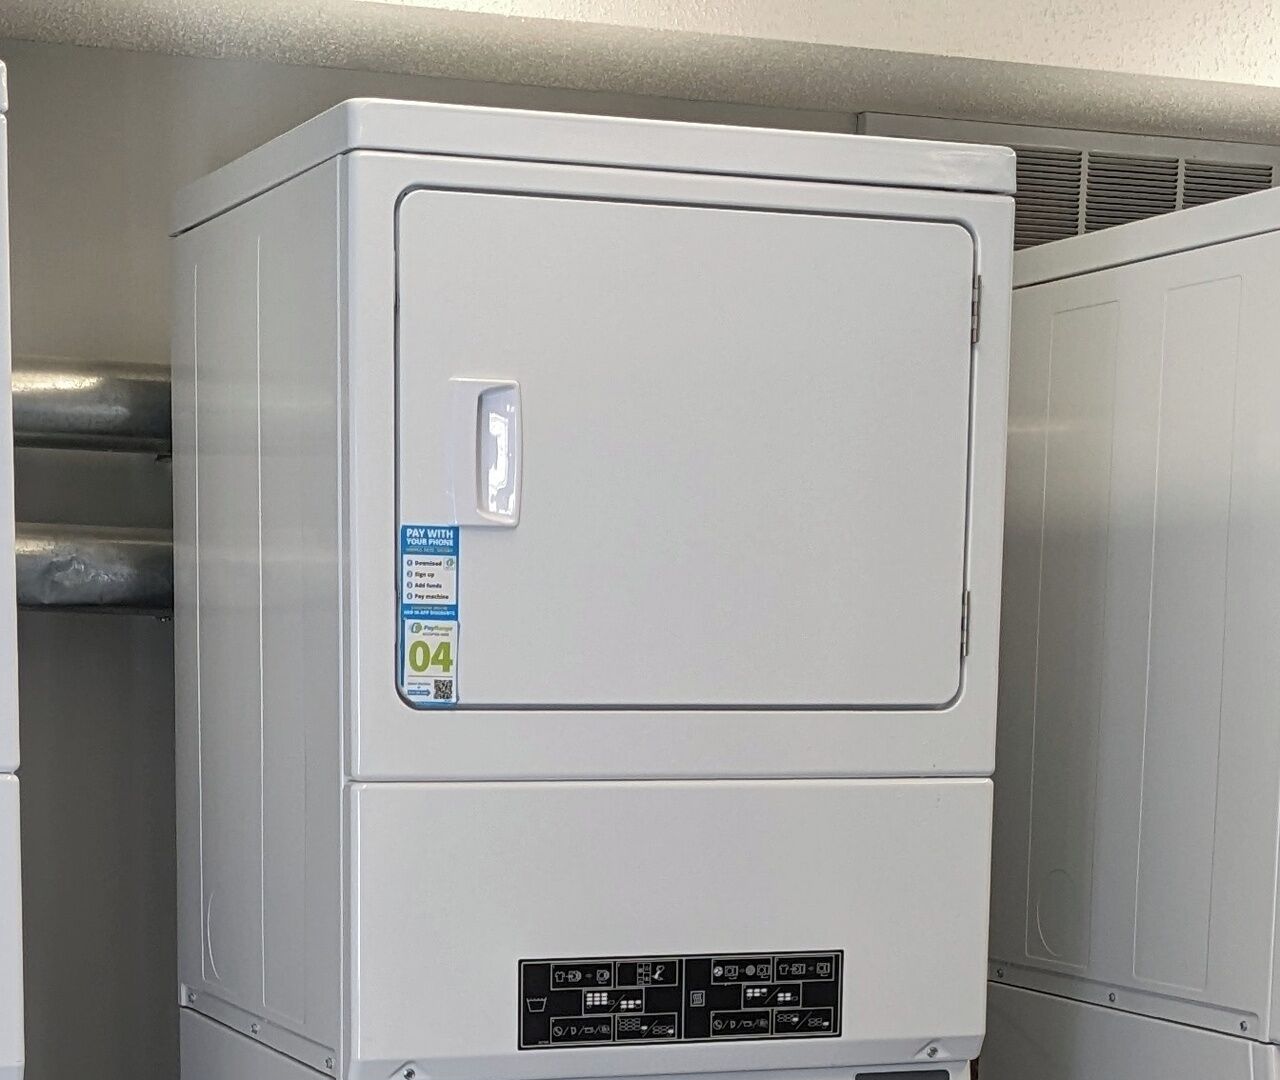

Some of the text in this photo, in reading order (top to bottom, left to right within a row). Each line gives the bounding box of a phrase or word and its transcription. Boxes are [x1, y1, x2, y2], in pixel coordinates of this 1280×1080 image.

[407, 528, 454, 539] PAY WITH
[428, 539, 454, 547] PHONE
[408, 641, 454, 673] 04
